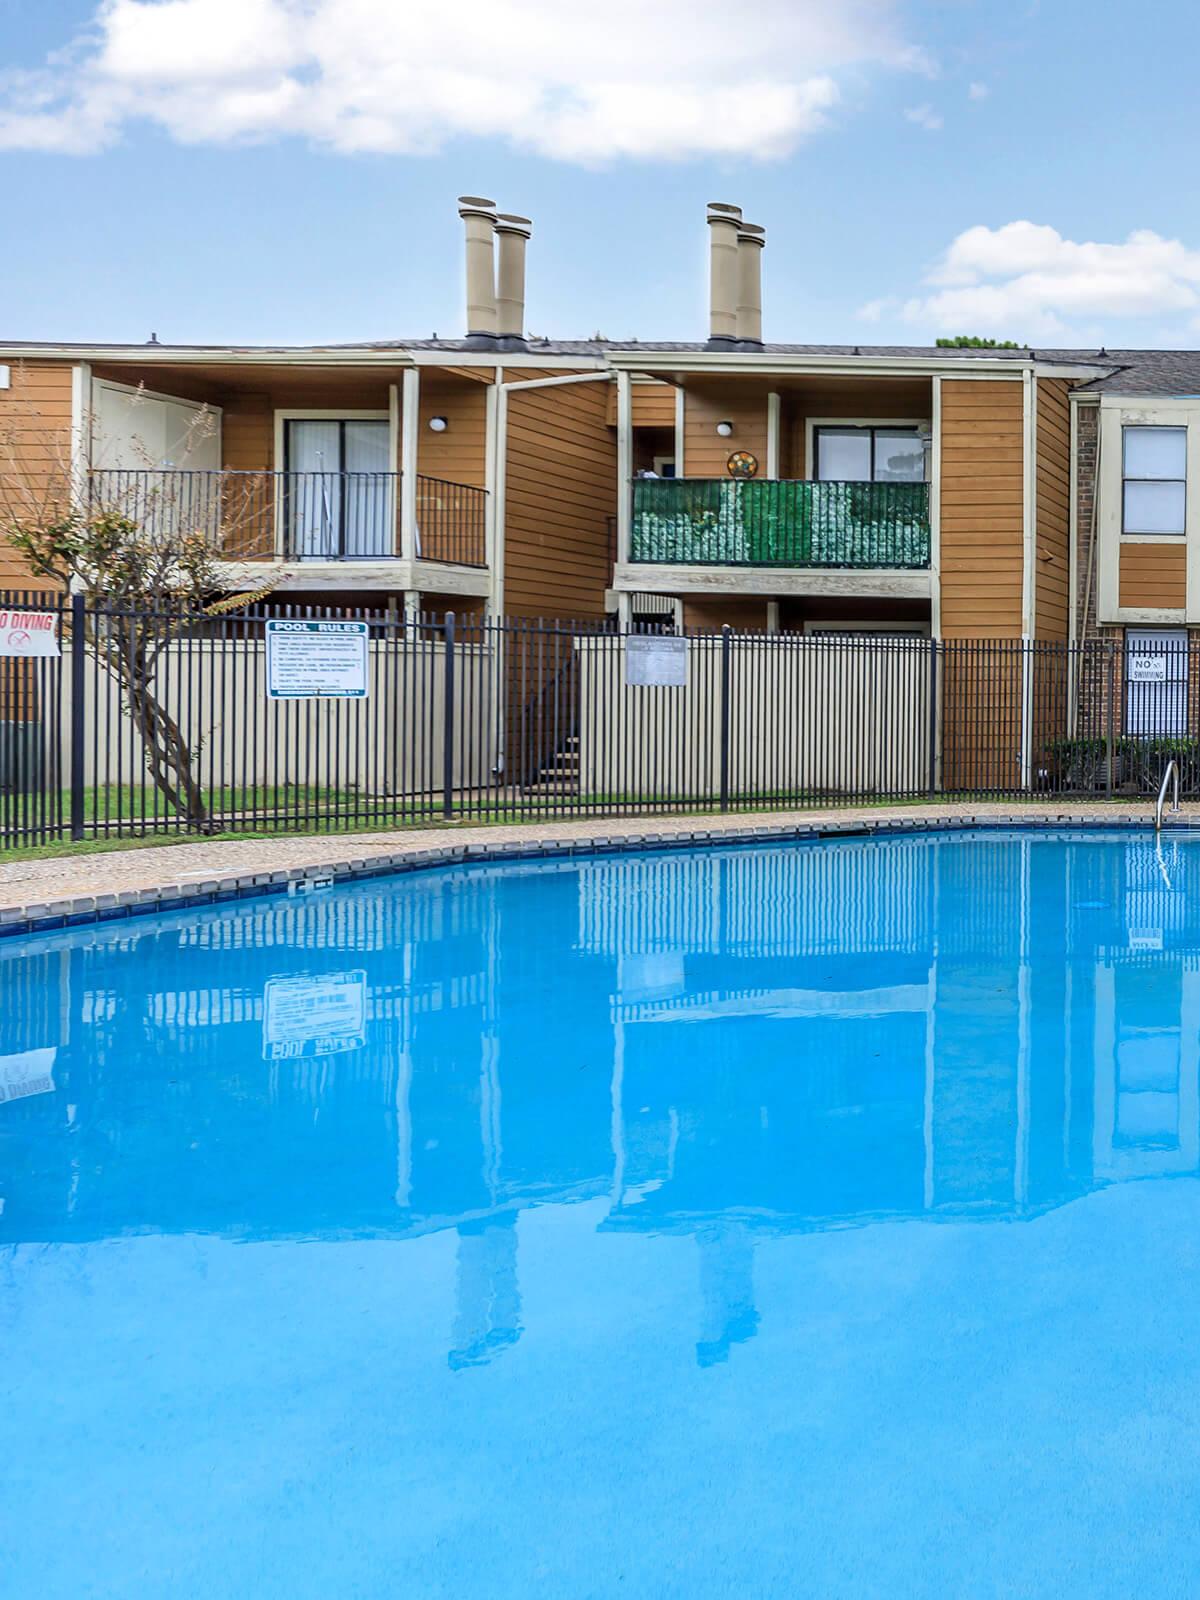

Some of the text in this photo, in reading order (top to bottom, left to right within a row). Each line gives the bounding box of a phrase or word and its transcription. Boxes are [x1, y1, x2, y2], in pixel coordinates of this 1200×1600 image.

[0, 613, 53, 630] O DIVING
[275, 623, 360, 632] POOL RULES
[1135, 660, 1151, 669] NO
[1134, 671, 1164, 680] SWIMMING
